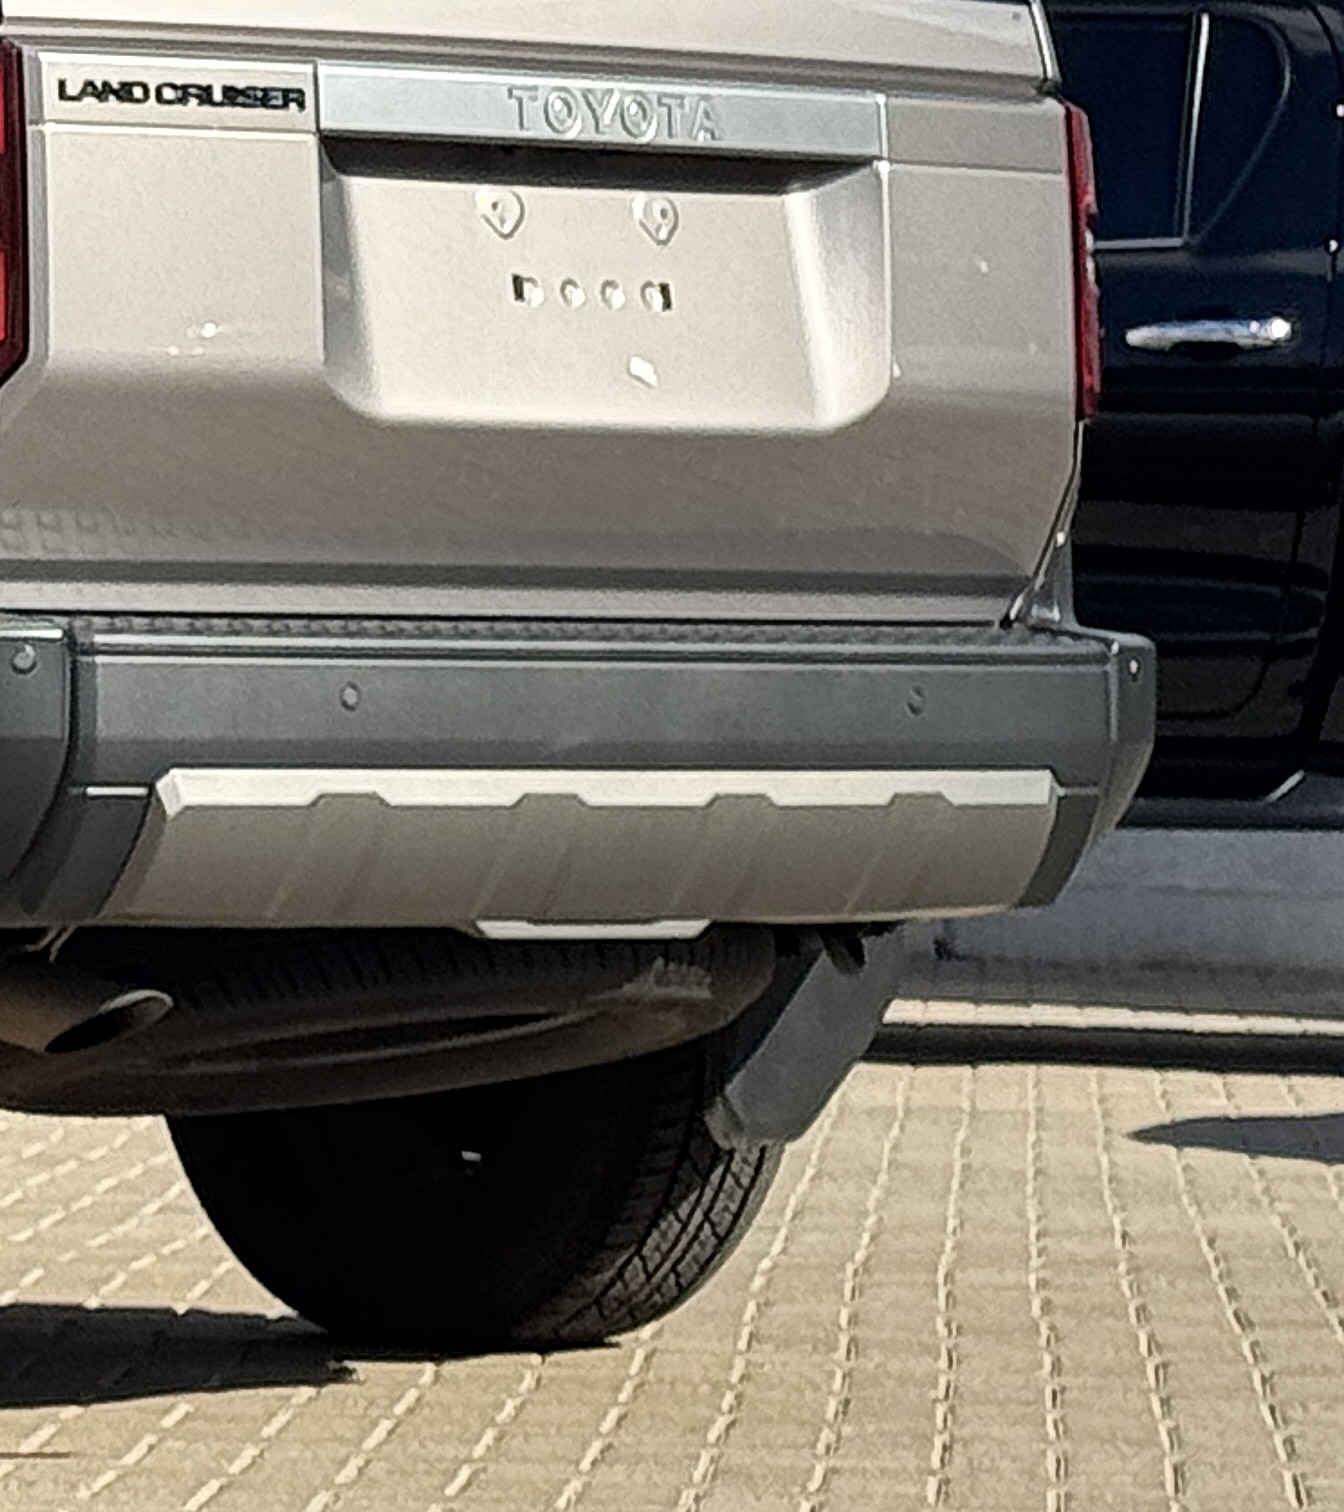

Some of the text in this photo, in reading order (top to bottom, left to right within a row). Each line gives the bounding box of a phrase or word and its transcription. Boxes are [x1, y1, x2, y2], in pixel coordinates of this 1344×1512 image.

[58, 78, 306, 112] LAND CRUISER
[506, 85, 723, 144] TOYOTA
